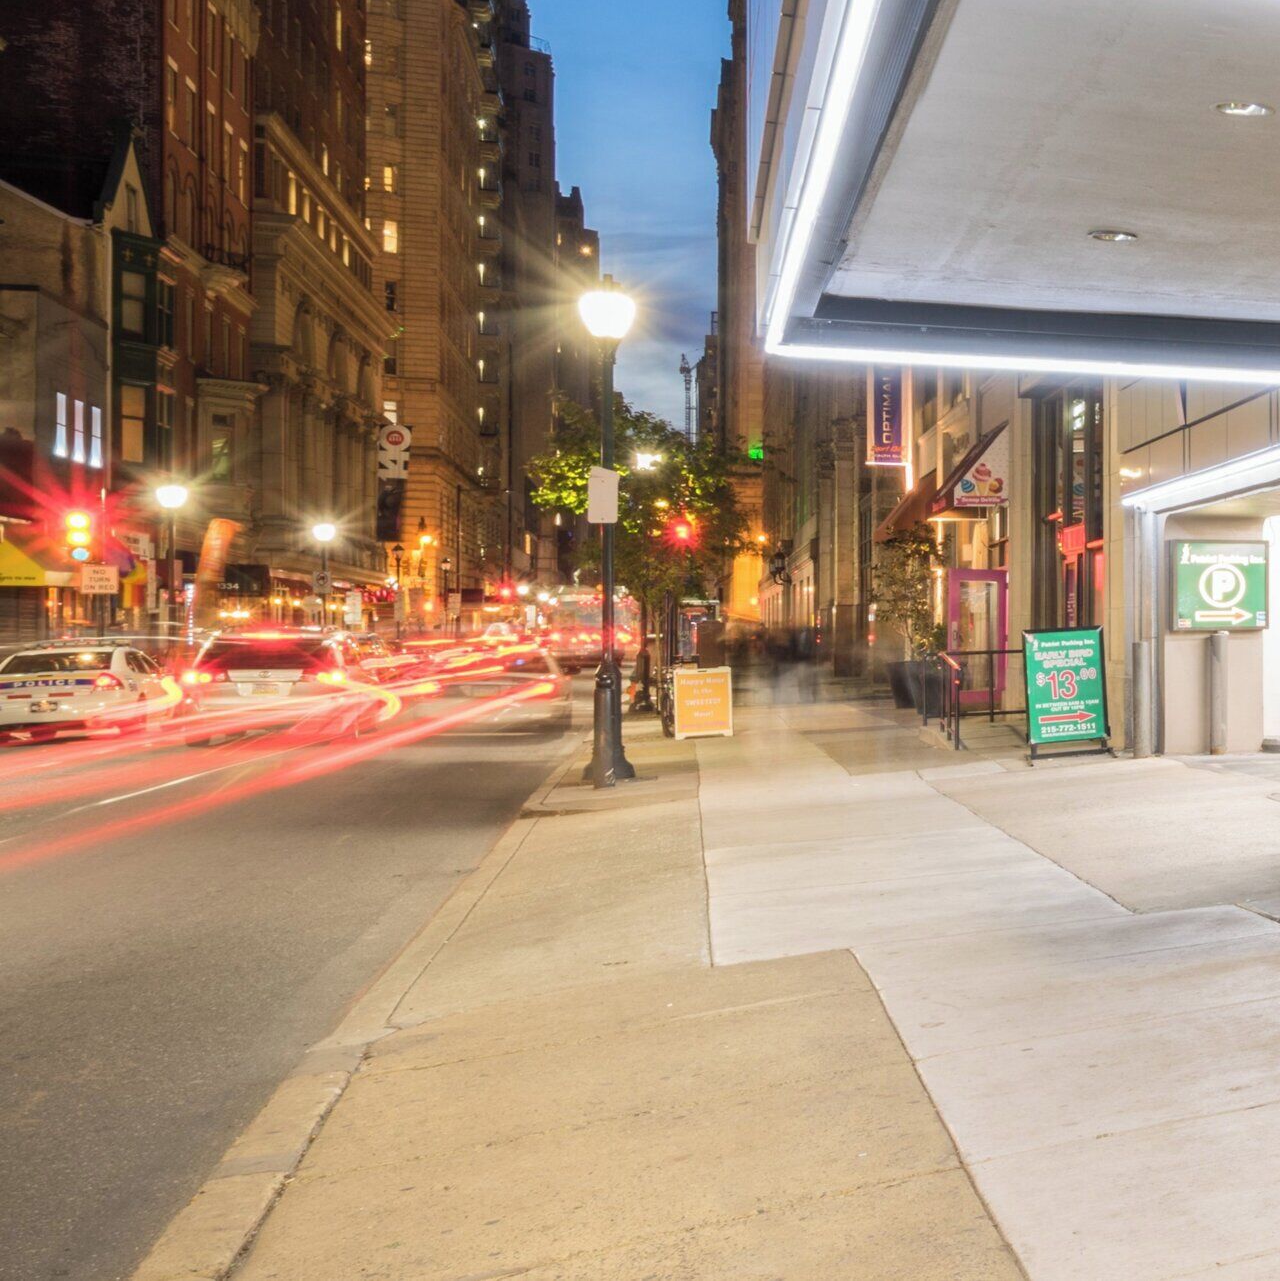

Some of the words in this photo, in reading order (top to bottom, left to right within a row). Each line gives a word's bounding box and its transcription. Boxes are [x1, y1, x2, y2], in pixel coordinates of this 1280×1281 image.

[1212, 570, 1236, 600] P
[1034, 650, 1066, 661] EARLY
[1068, 648, 1094, 659] BIRD
[1043, 657, 1087, 668] SPECIAL
[13, 679, 77, 687] POLICE
[1041, 722, 1096, 734] 215-772-1511
